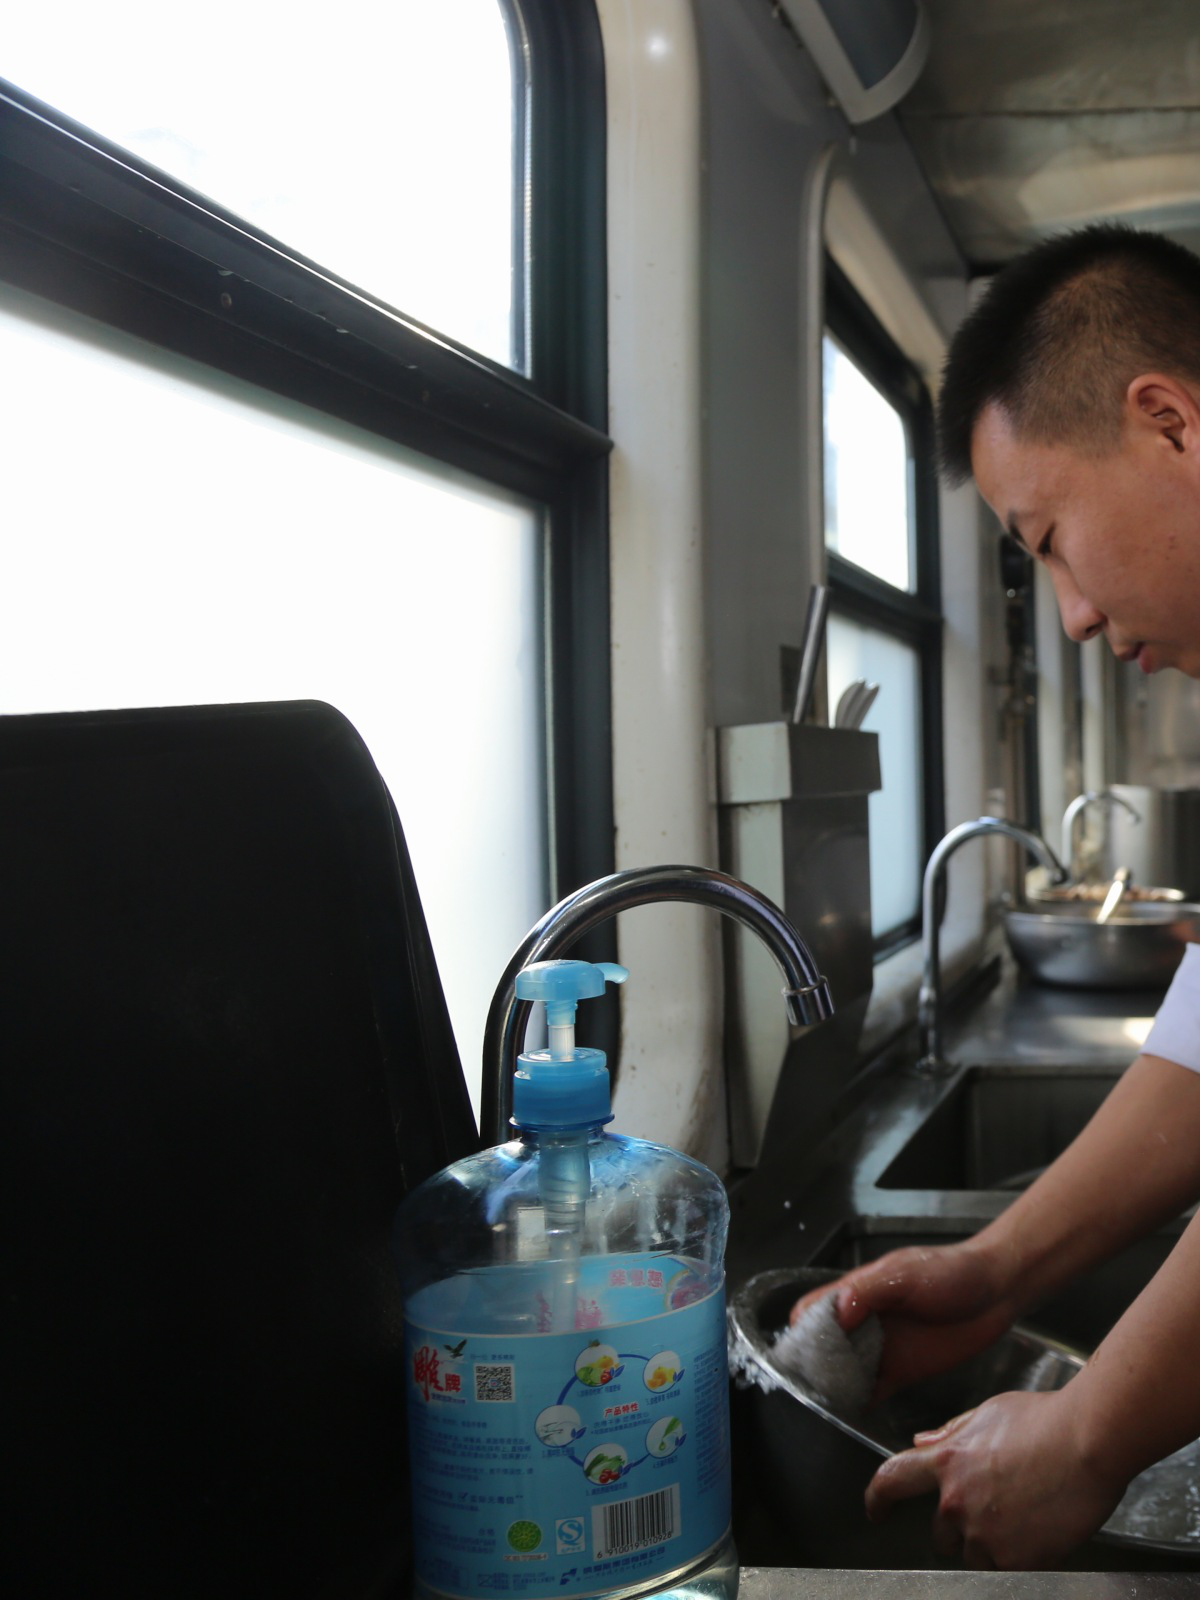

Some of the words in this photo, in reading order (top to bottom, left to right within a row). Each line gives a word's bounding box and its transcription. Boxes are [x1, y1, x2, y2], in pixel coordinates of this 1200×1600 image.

[604, 1402, 640, 1418] 产品特性
[607, 1541, 640, 1557] 910019
